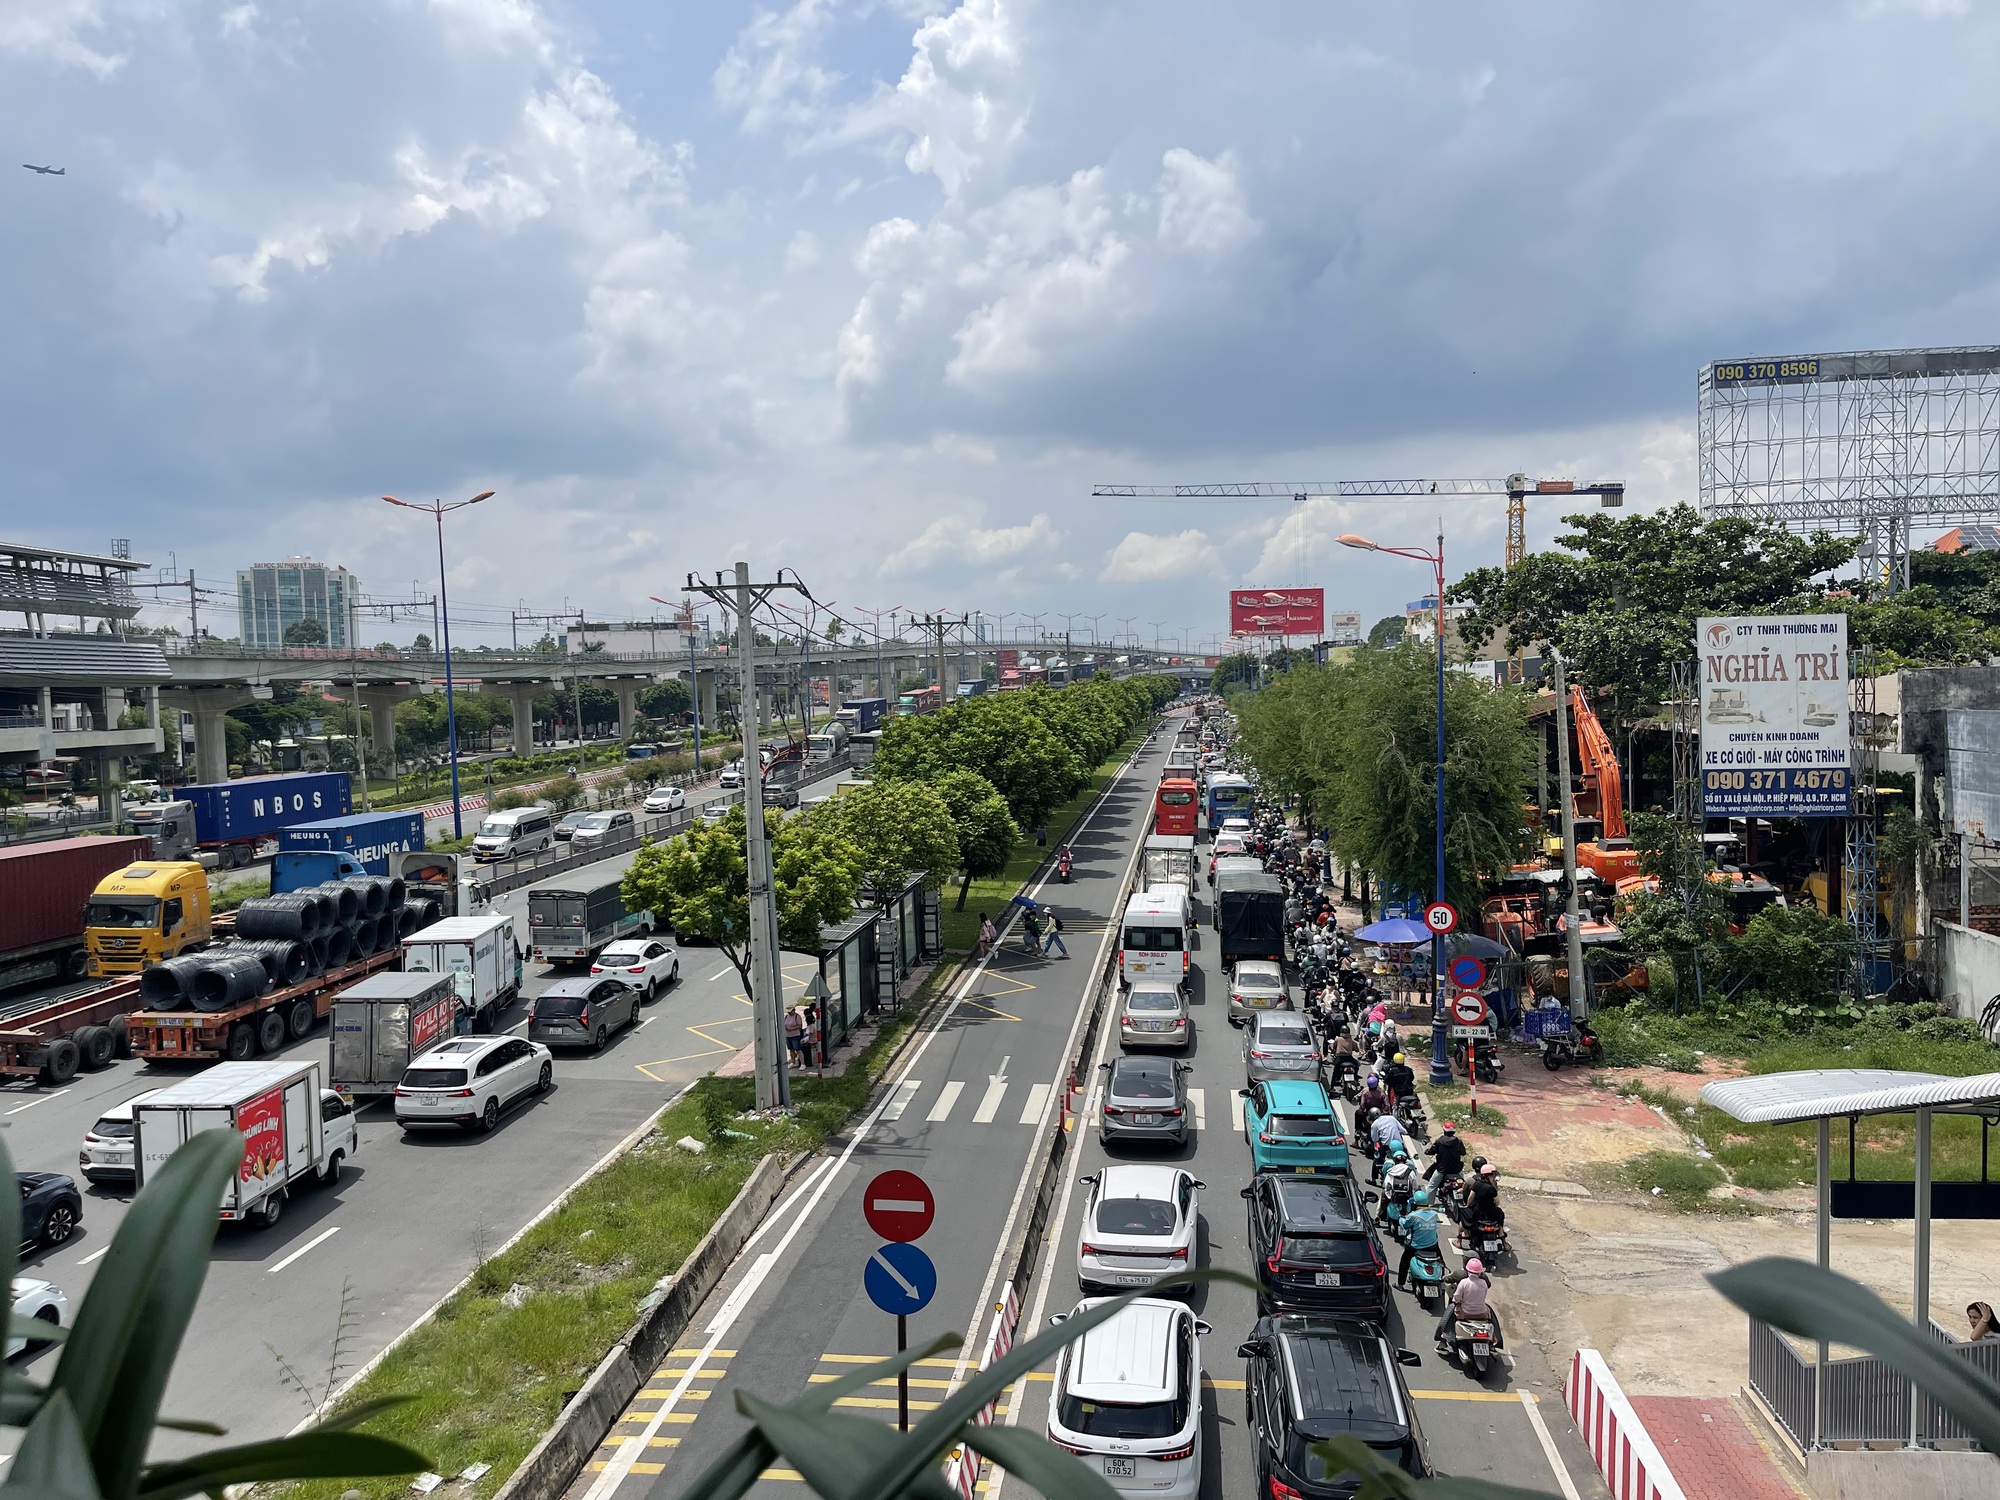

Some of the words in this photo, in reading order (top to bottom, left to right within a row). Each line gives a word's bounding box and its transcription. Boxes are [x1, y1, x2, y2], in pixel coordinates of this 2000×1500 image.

[1717, 366, 1744, 380] 090
[1748, 364, 1776, 379] 370
[1780, 361, 1817, 377] 8596
[1737, 625, 1753, 636] CTY
[1757, 624, 1781, 635] TNHH
[1783, 622, 1818, 635] THƯƠNG
[1820, 623, 1838, 636] MẠI
[1706, 646, 1789, 683] NGHĨA
[1794, 643, 1839, 681] TRÍ
[1729, 731, 1763, 742] CHUYÊN
[1766, 732, 1787, 741] KINH
[1789, 731, 1819, 741] DOANH
[1705, 751, 1718, 764] XE
[1720, 748, 1734, 764] CƠ
[1764, 747, 1783, 764] MÁY
[1785, 746, 1813, 763] CÔNG
[1815, 746, 1845, 762] TRÌNH
[1707, 771, 1745, 790] 090
[1750, 771, 1786, 789] 371
[1793, 770, 1846, 789] 4679
[1704, 792, 1714, 803] SỐ
[1714, 795, 1722, 803] 01
[1723, 794, 1733, 803] XA
[1733, 792, 1742, 805] LỘ
[1742, 792, 1752, 803] HÀ
[1830, 794, 1847, 802] HCM
[290, 832, 321, 840] HEUNG
[354, 841, 399, 864] HEUNG
[401, 839, 411, 852] A
[1433, 911, 1448, 925] 50
[1112, 1459, 1126, 1467] 60K
[1107, 1466, 1132, 1475] 670.52
